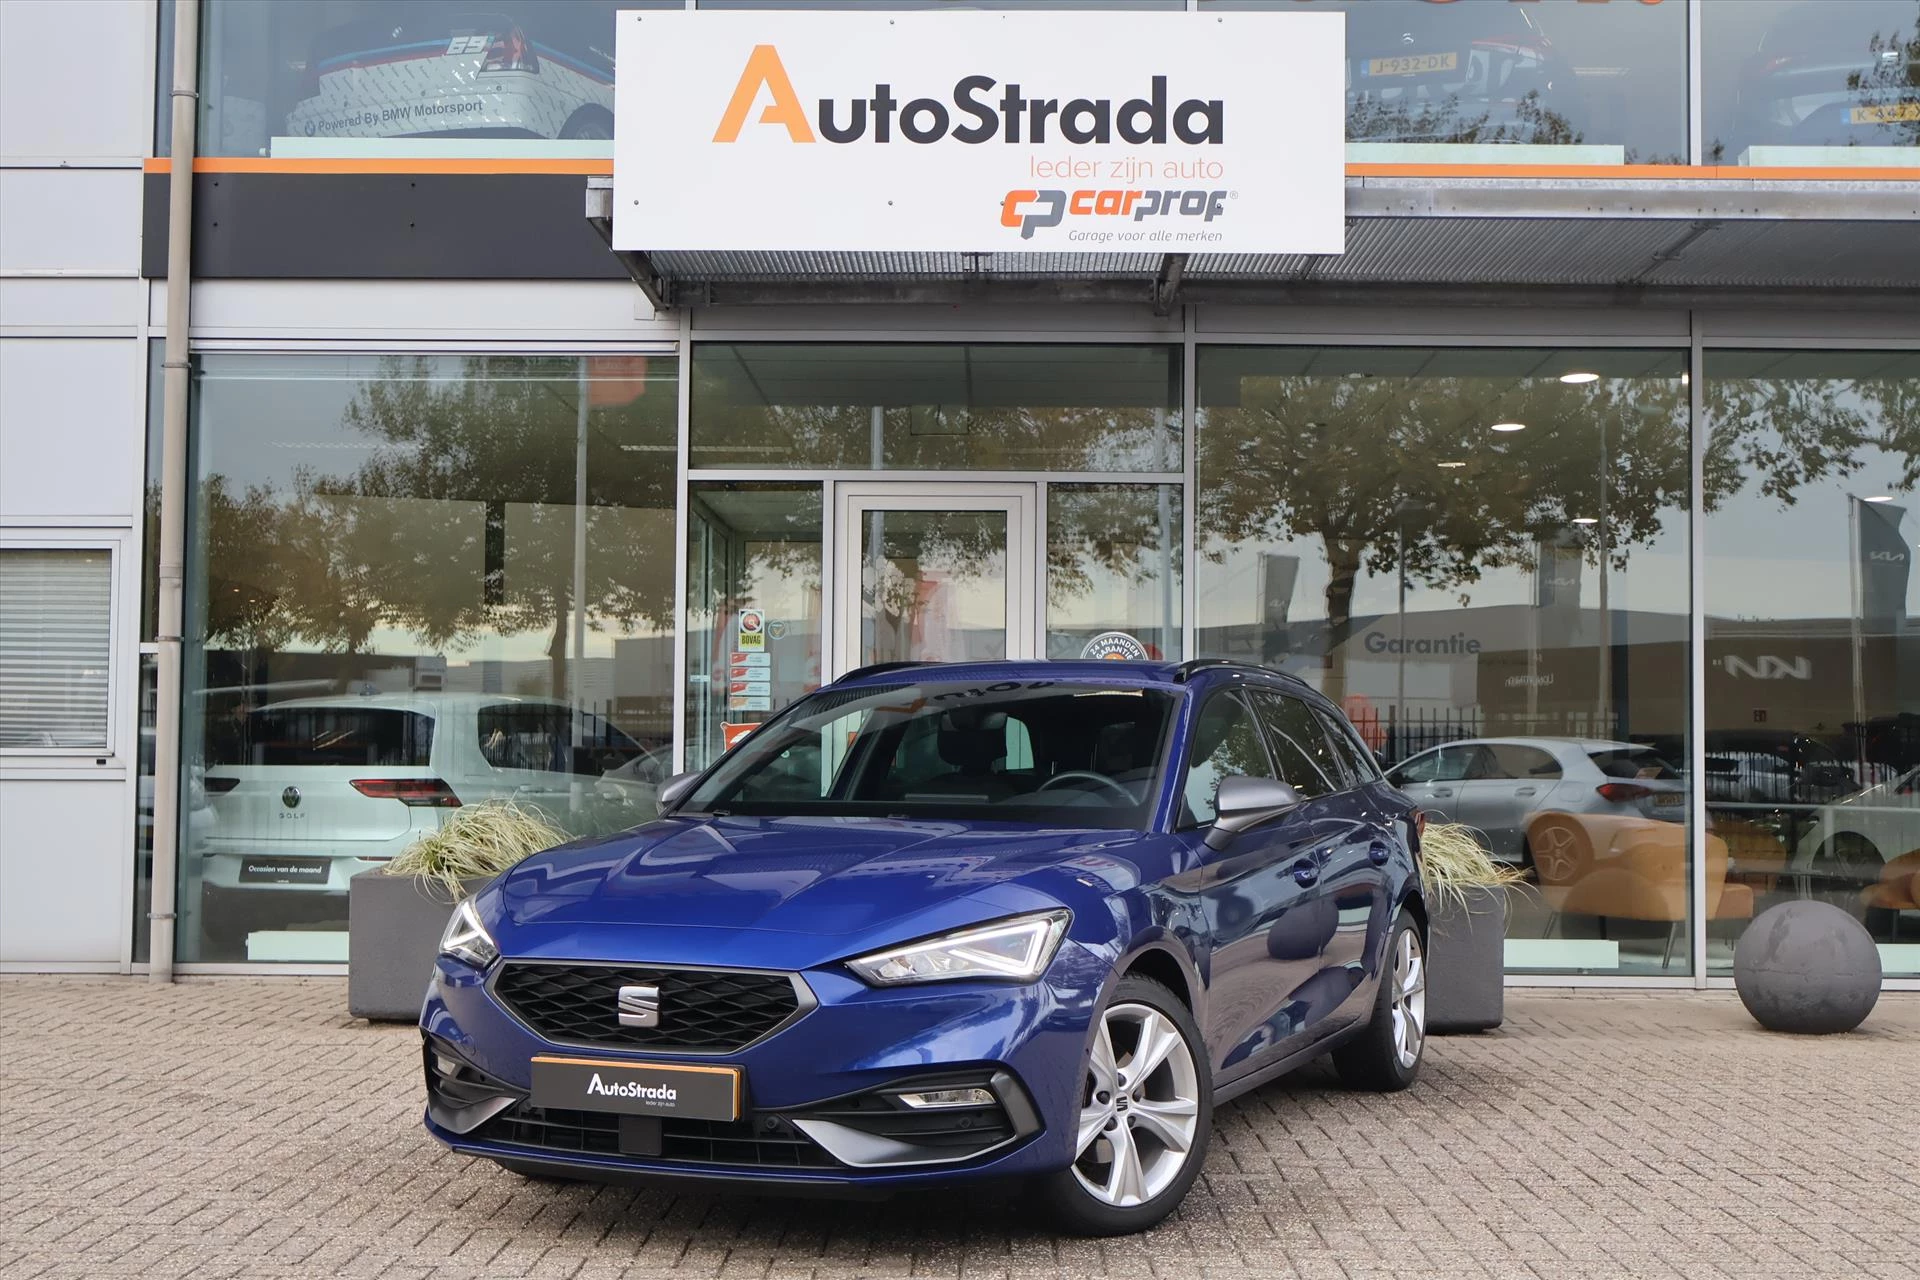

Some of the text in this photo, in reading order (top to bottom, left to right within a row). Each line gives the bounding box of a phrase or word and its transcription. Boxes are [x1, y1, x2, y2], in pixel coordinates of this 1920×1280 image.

[445, 35, 488, 55] 69
[1375, 54, 1450, 74] J-932-DK
[711, 44, 1224, 145] AutoStrada
[318, 100, 483, 132] Powered By BMW Motorsport
[1030, 155, 1224, 184] Ieder zijn auto
[1068, 229, 1223, 244] Garage voor alle merken
[741, 634, 762, 645] BOVAG
[1089, 637, 1141, 657] 24 MAANDEN
[1363, 630, 1482, 655] Garantie
[248, 864, 276, 873] Occasion
[289, 865, 298, 873] de
[298, 865, 322, 874] maand
[586, 1072, 677, 1101] AutoStrada
